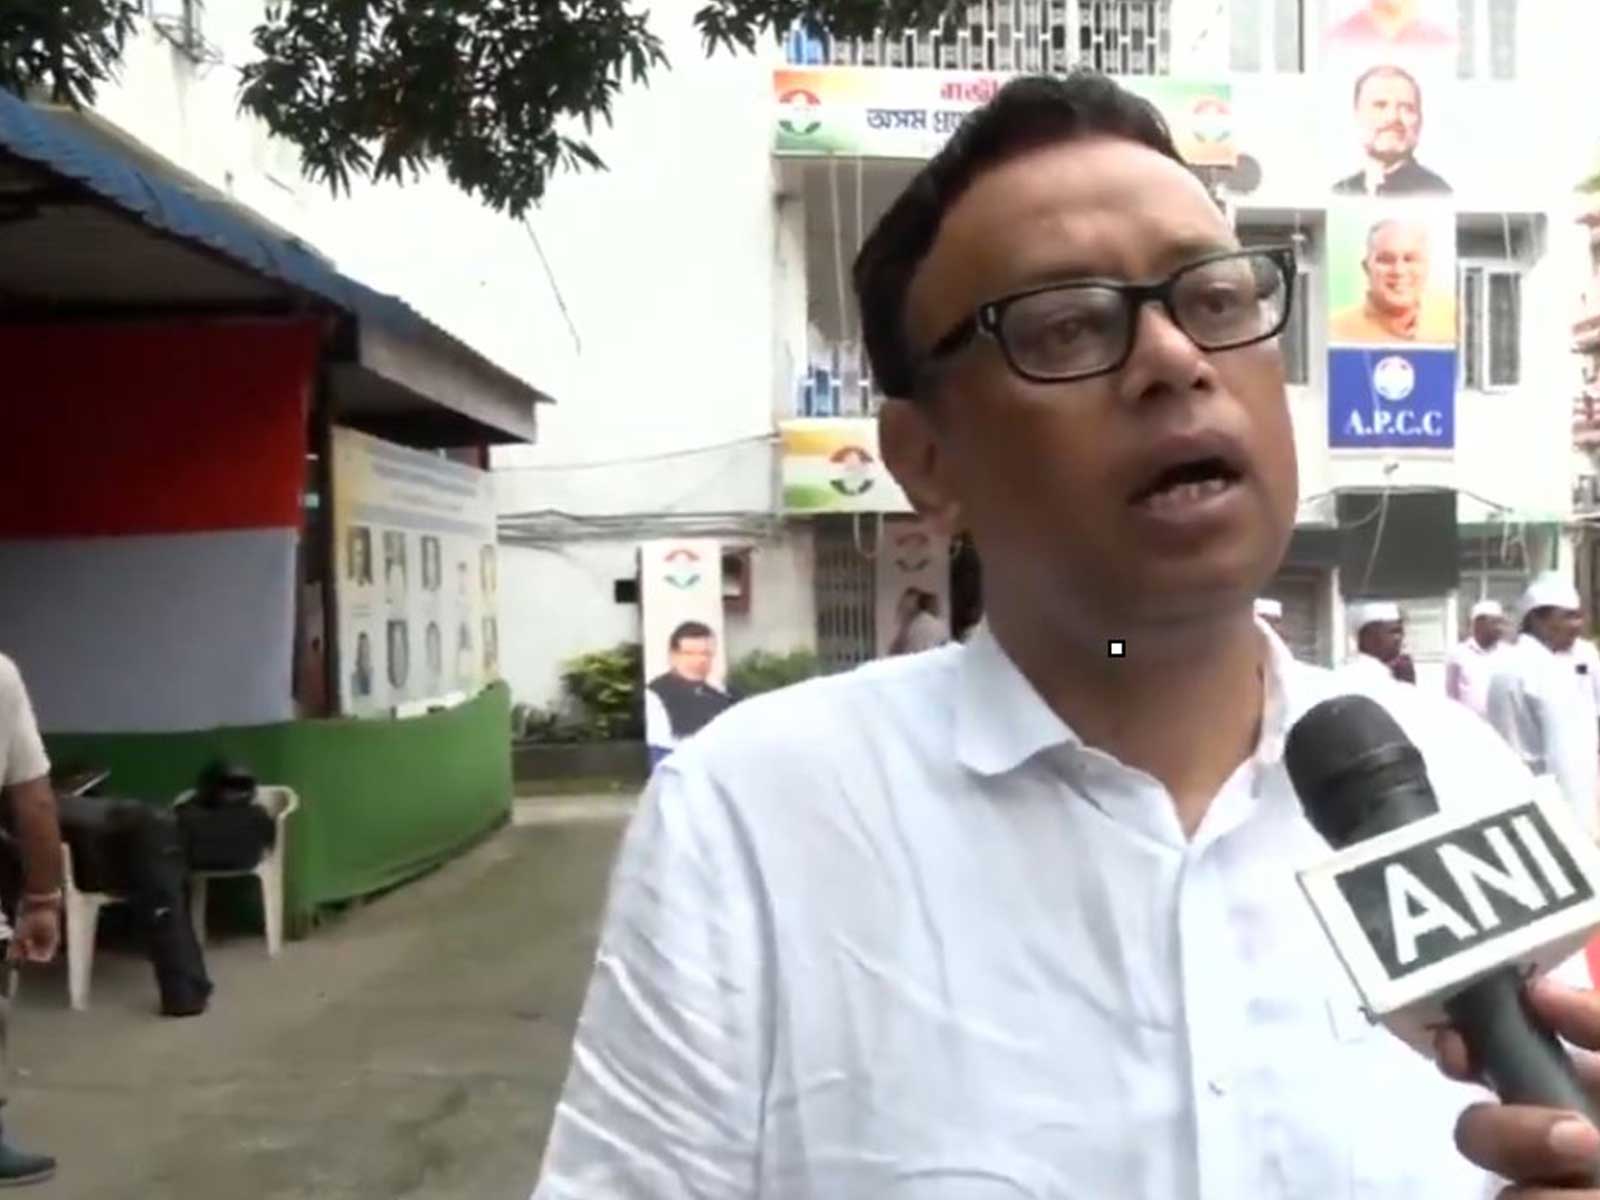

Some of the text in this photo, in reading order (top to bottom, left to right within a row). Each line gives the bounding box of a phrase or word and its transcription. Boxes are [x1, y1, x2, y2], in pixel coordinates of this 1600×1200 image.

[867, 109, 927, 129] অসম
[1345, 409, 1443, 436] A.P.C.C
[1384, 815, 1576, 964] ANI
